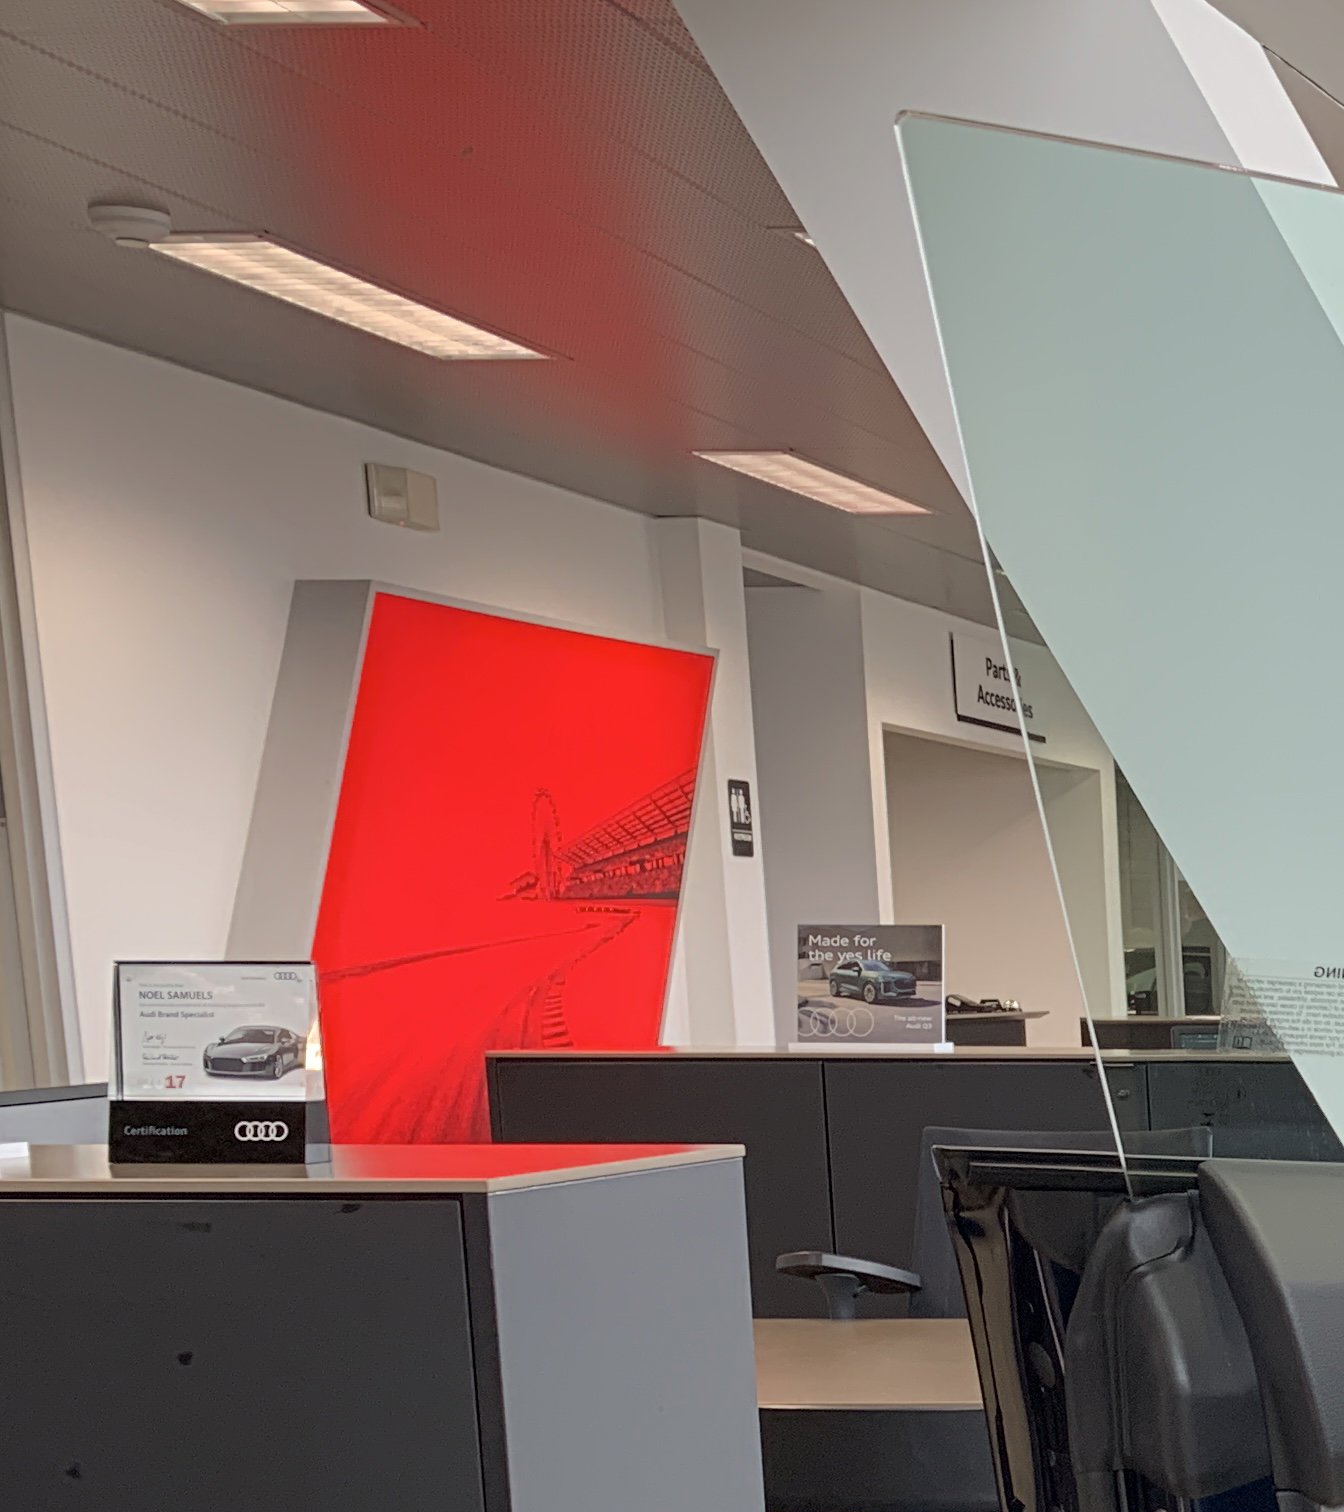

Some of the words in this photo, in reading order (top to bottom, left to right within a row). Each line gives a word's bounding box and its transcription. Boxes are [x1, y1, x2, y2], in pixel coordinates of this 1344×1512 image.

[808, 935, 849, 947] Made
[853, 935, 876, 947] for
[808, 950, 833, 961] the
[837, 951, 863, 963] yes
[867, 949, 892, 961] life
[138, 991, 165, 1000] NOEL
[167, 991, 213, 1000] SAMUELS
[180, 1011, 214, 1020] Specialist
[124, 1125, 188, 1136] Certification
